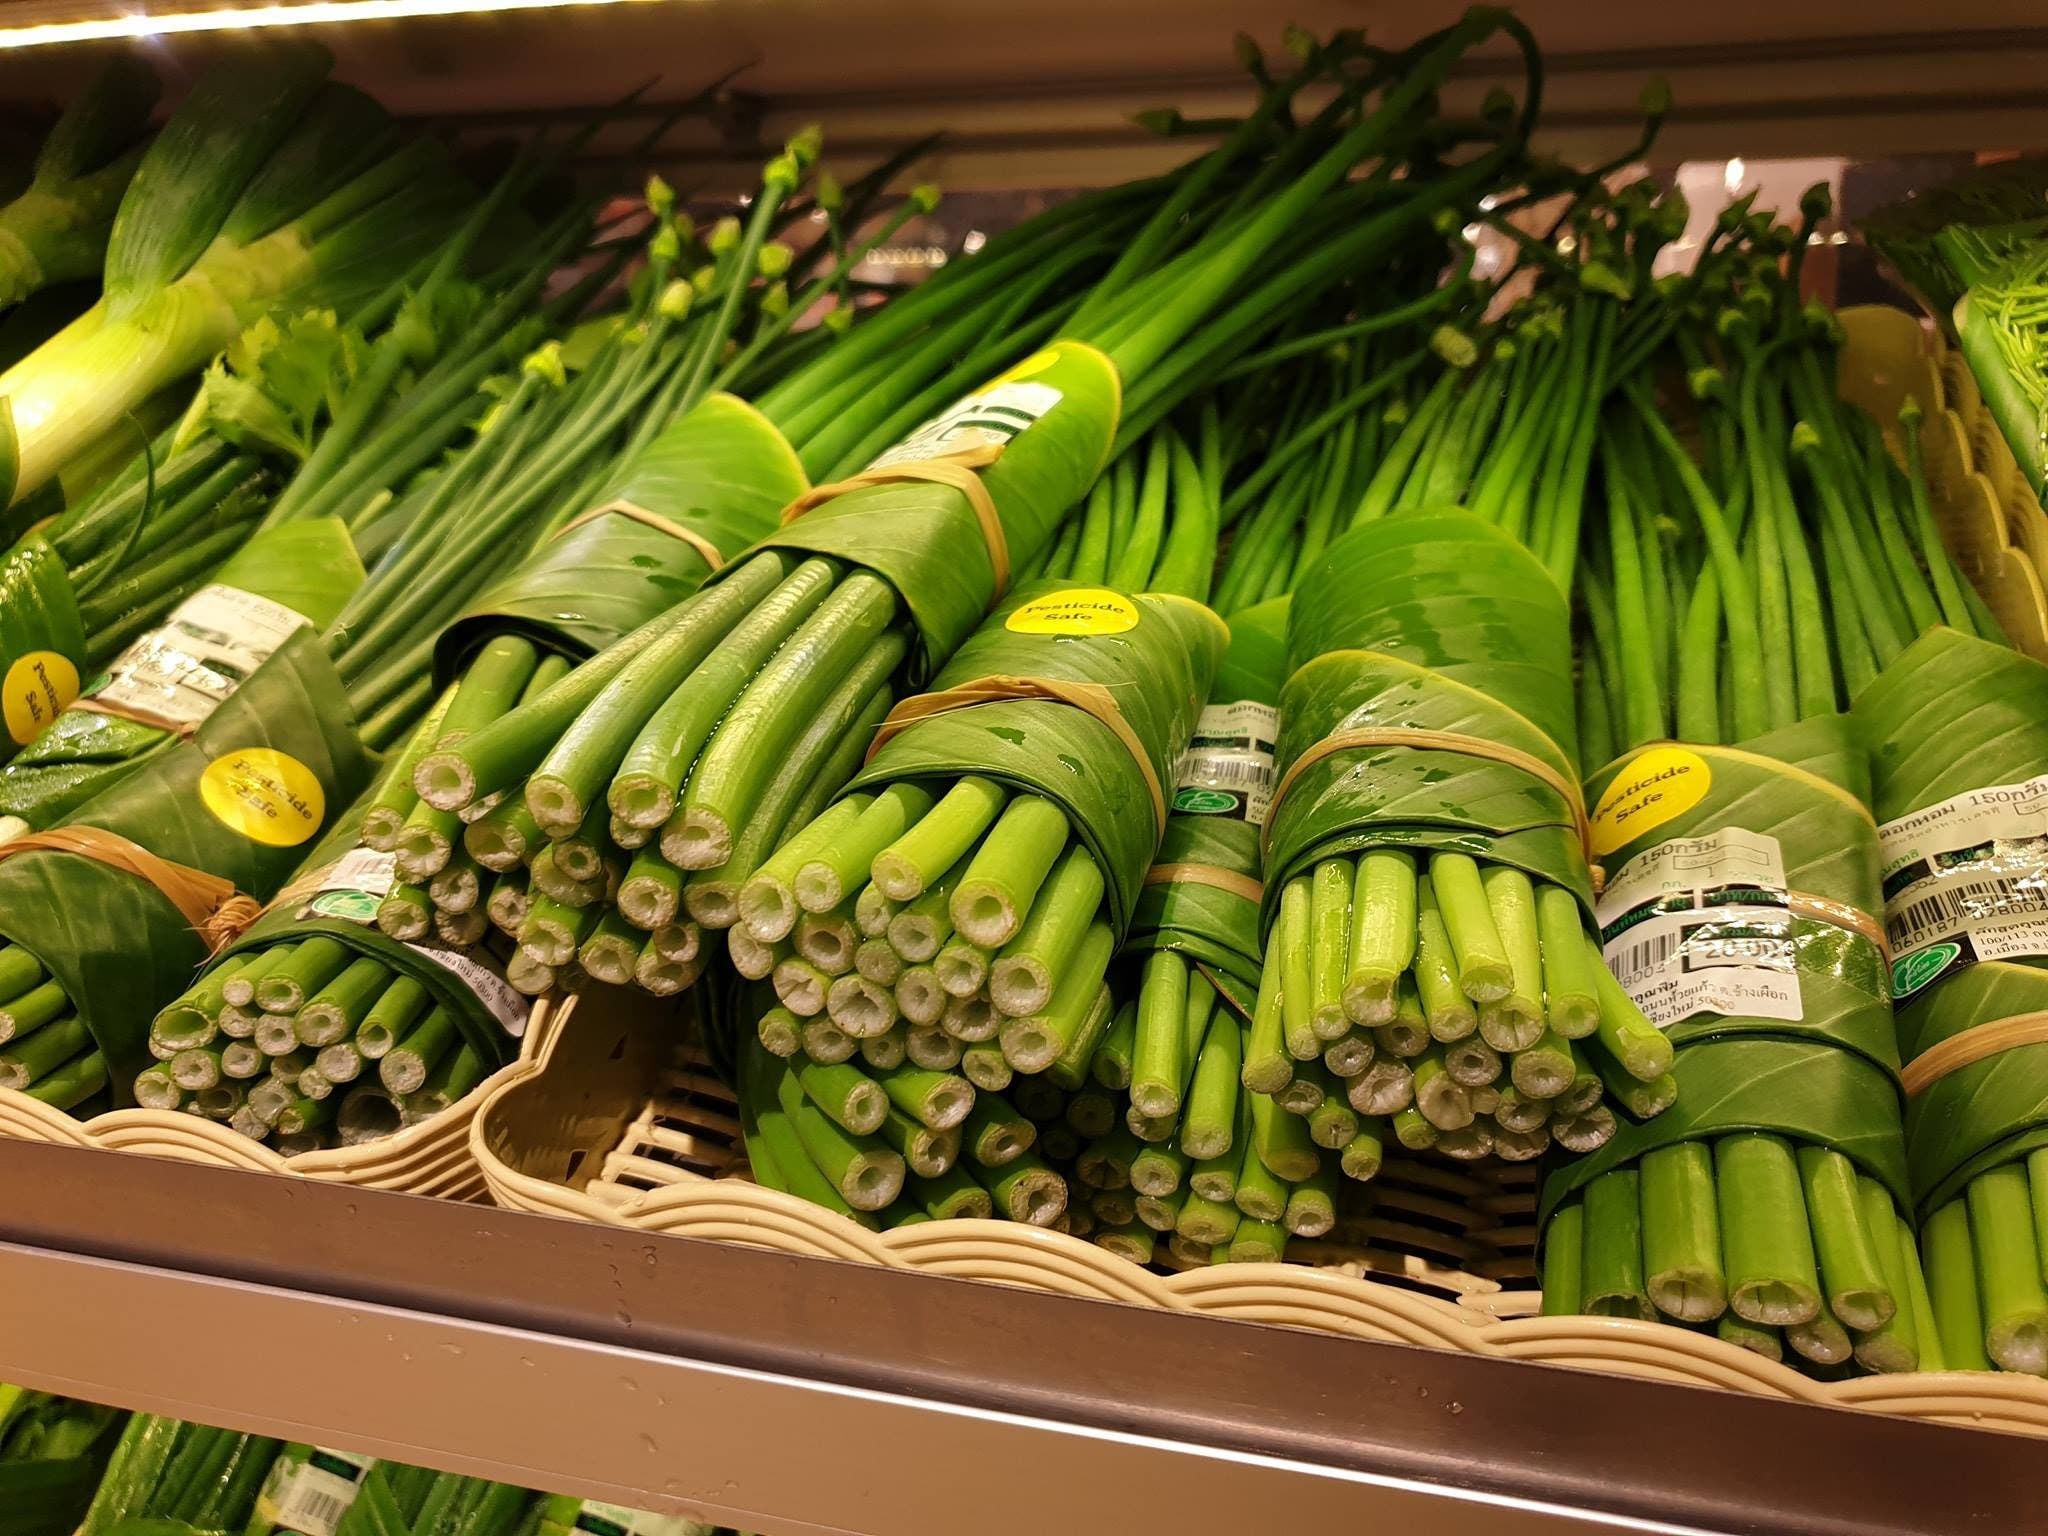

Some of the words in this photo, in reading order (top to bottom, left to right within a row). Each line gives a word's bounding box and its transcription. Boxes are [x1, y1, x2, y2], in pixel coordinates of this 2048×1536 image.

[1024, 602, 1125, 614] Pesticide
[233, 759, 313, 819] Pesticide
[234, 784, 278, 818] Safe
[1597, 765, 1690, 823] Pesticide
[1615, 793, 1663, 824] Safe
